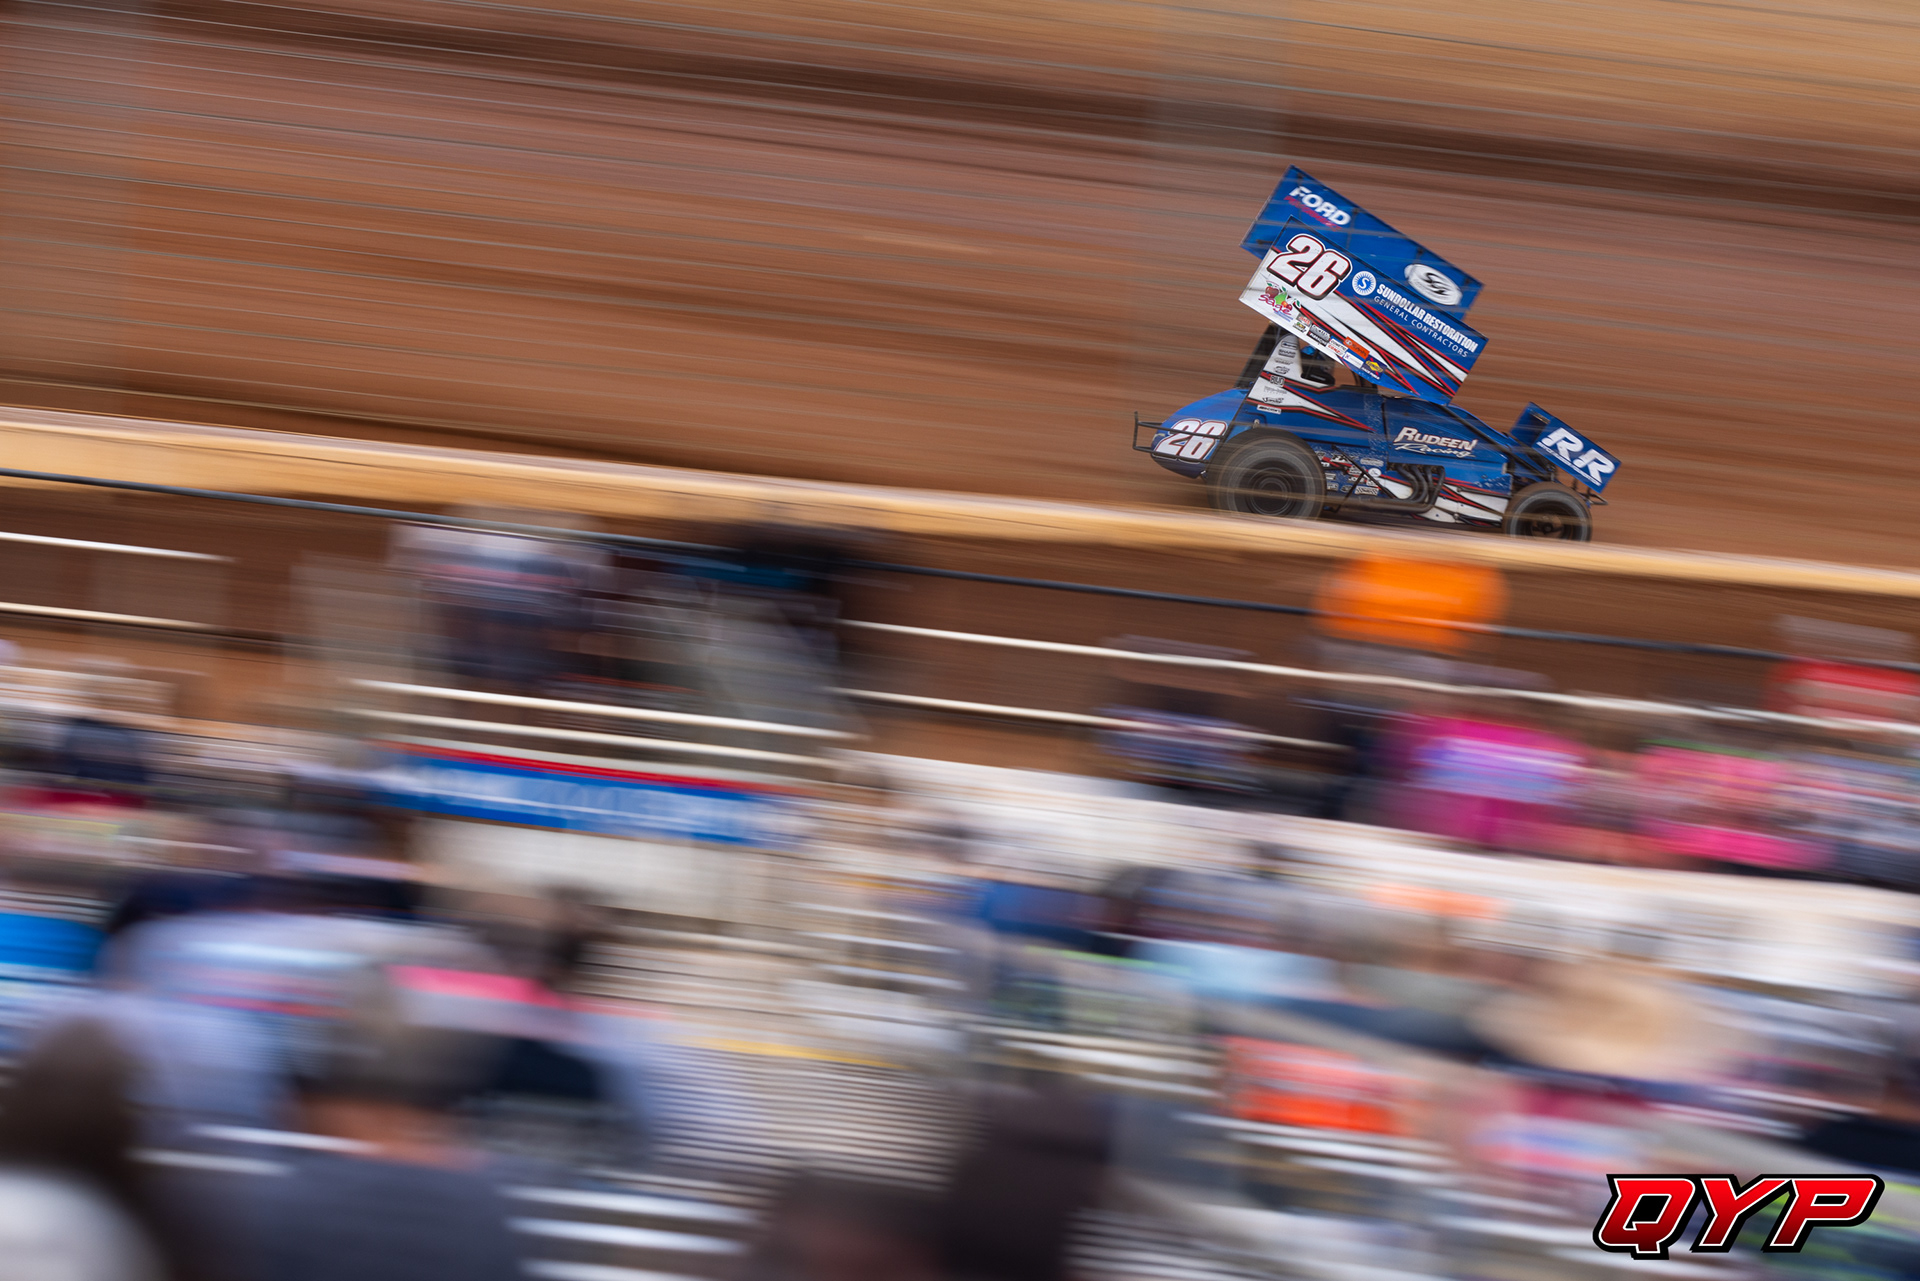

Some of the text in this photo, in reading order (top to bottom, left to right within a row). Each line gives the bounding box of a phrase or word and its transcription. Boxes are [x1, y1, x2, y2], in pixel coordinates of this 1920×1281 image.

[1289, 186, 1351, 225] FORD
[1267, 233, 1352, 301] 26
[1373, 296, 1469, 358] GENERAL CONTRACTORS
[1377, 284, 1426, 320] SUNDOLLAR
[1423, 313, 1478, 353] RESTORATION
[1393, 426, 1478, 451] RUDEEN
[1393, 443, 1477, 458] Racing
